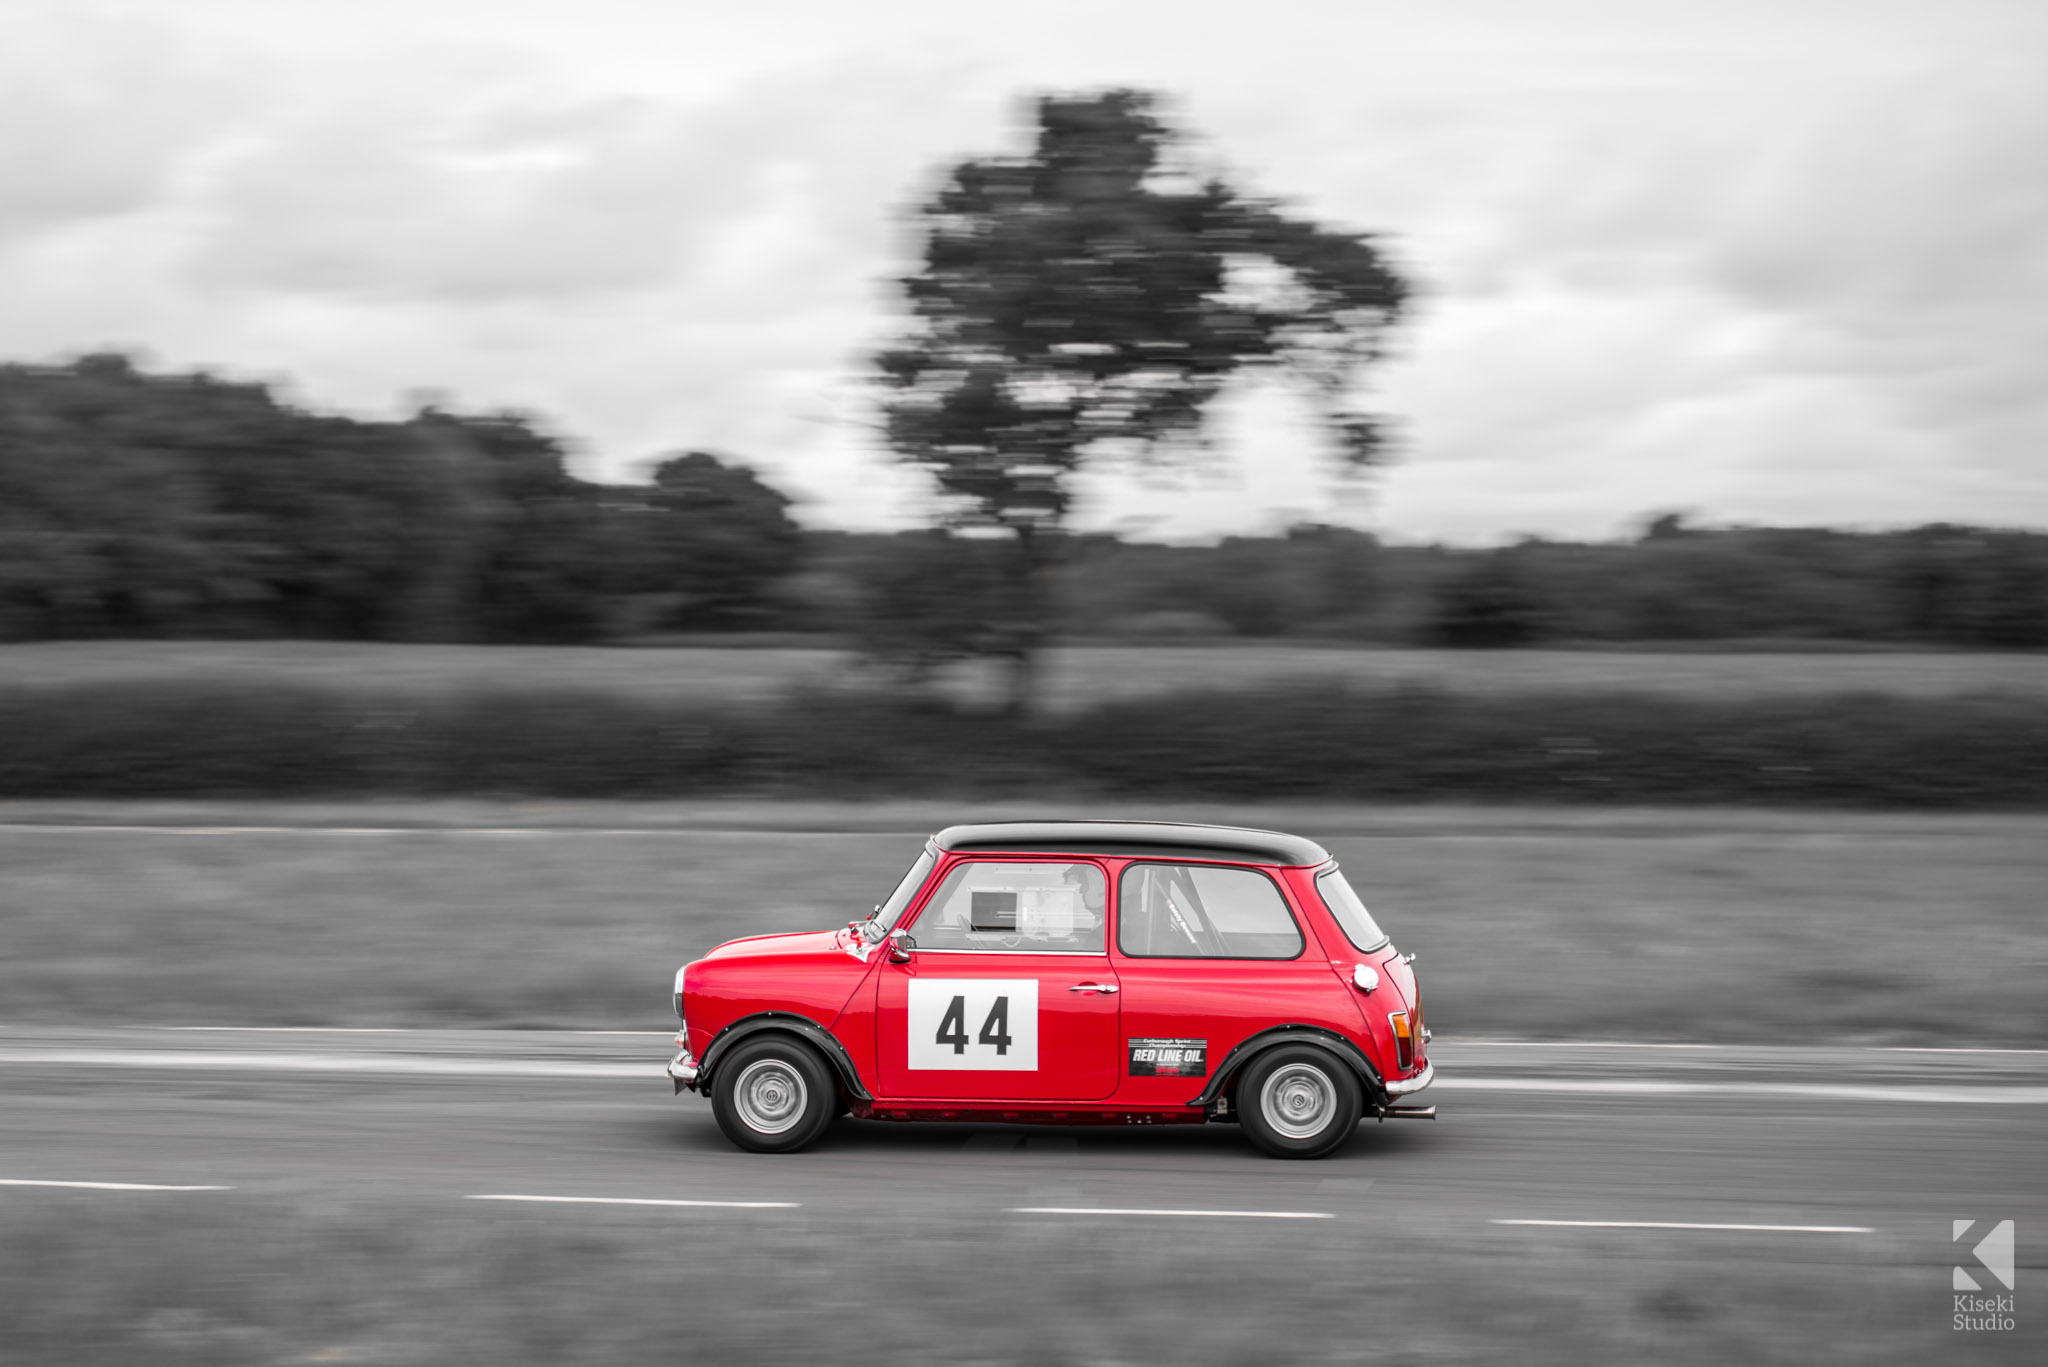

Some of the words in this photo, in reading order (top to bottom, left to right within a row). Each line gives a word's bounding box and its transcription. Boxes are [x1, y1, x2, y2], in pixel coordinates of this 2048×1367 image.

[935, 995, 1012, 1056] 44
[1132, 1049, 1156, 1062] RED
[1157, 1049, 1183, 1062] LINE
